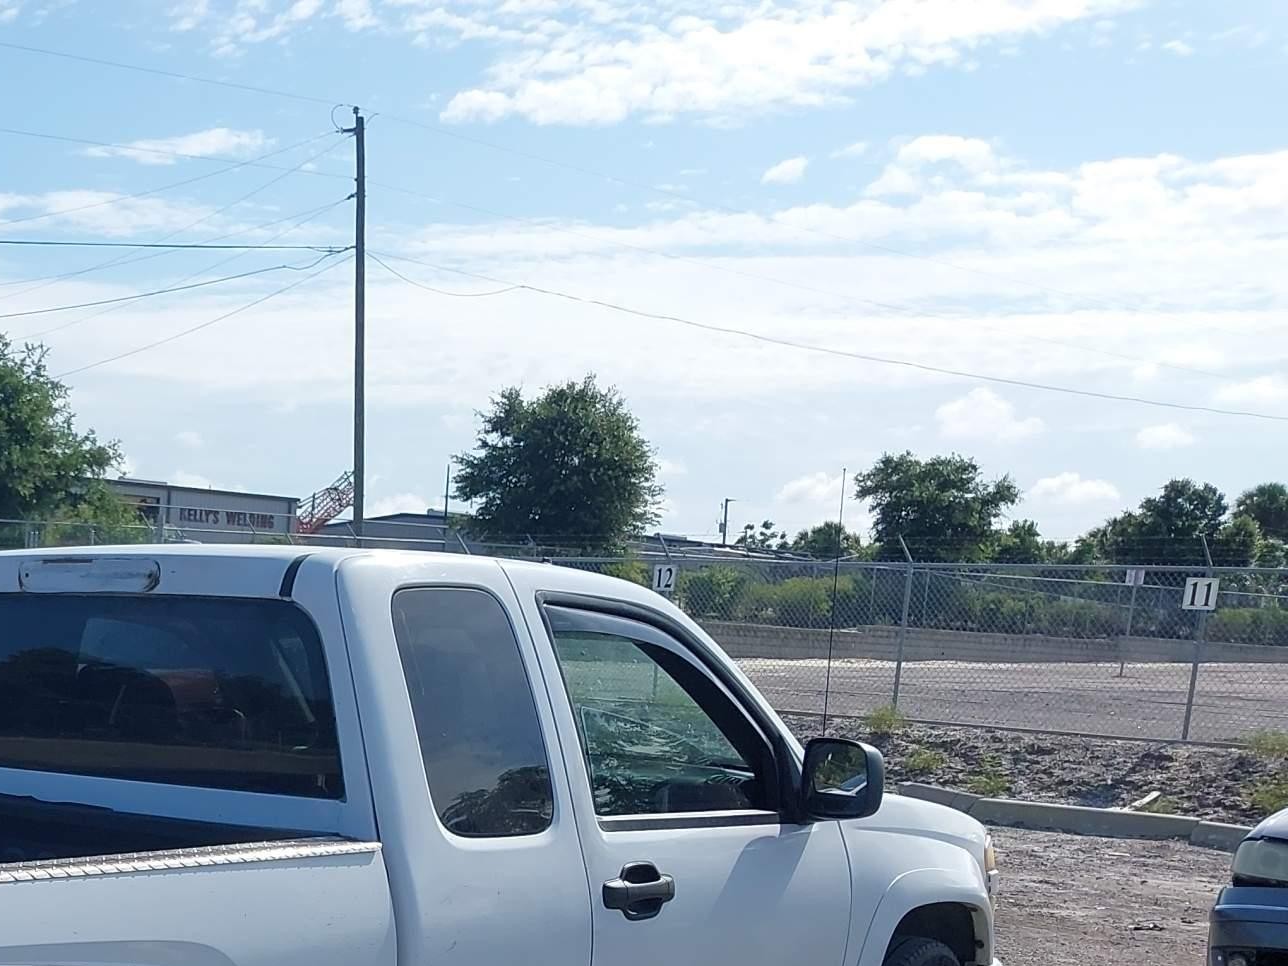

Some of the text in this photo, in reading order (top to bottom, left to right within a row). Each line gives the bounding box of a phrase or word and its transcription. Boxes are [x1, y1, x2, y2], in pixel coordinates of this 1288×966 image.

[179, 507, 275, 529] KELLY'S WELDING
[656, 567, 673, 589] 12
[1189, 581, 1213, 607] 11
